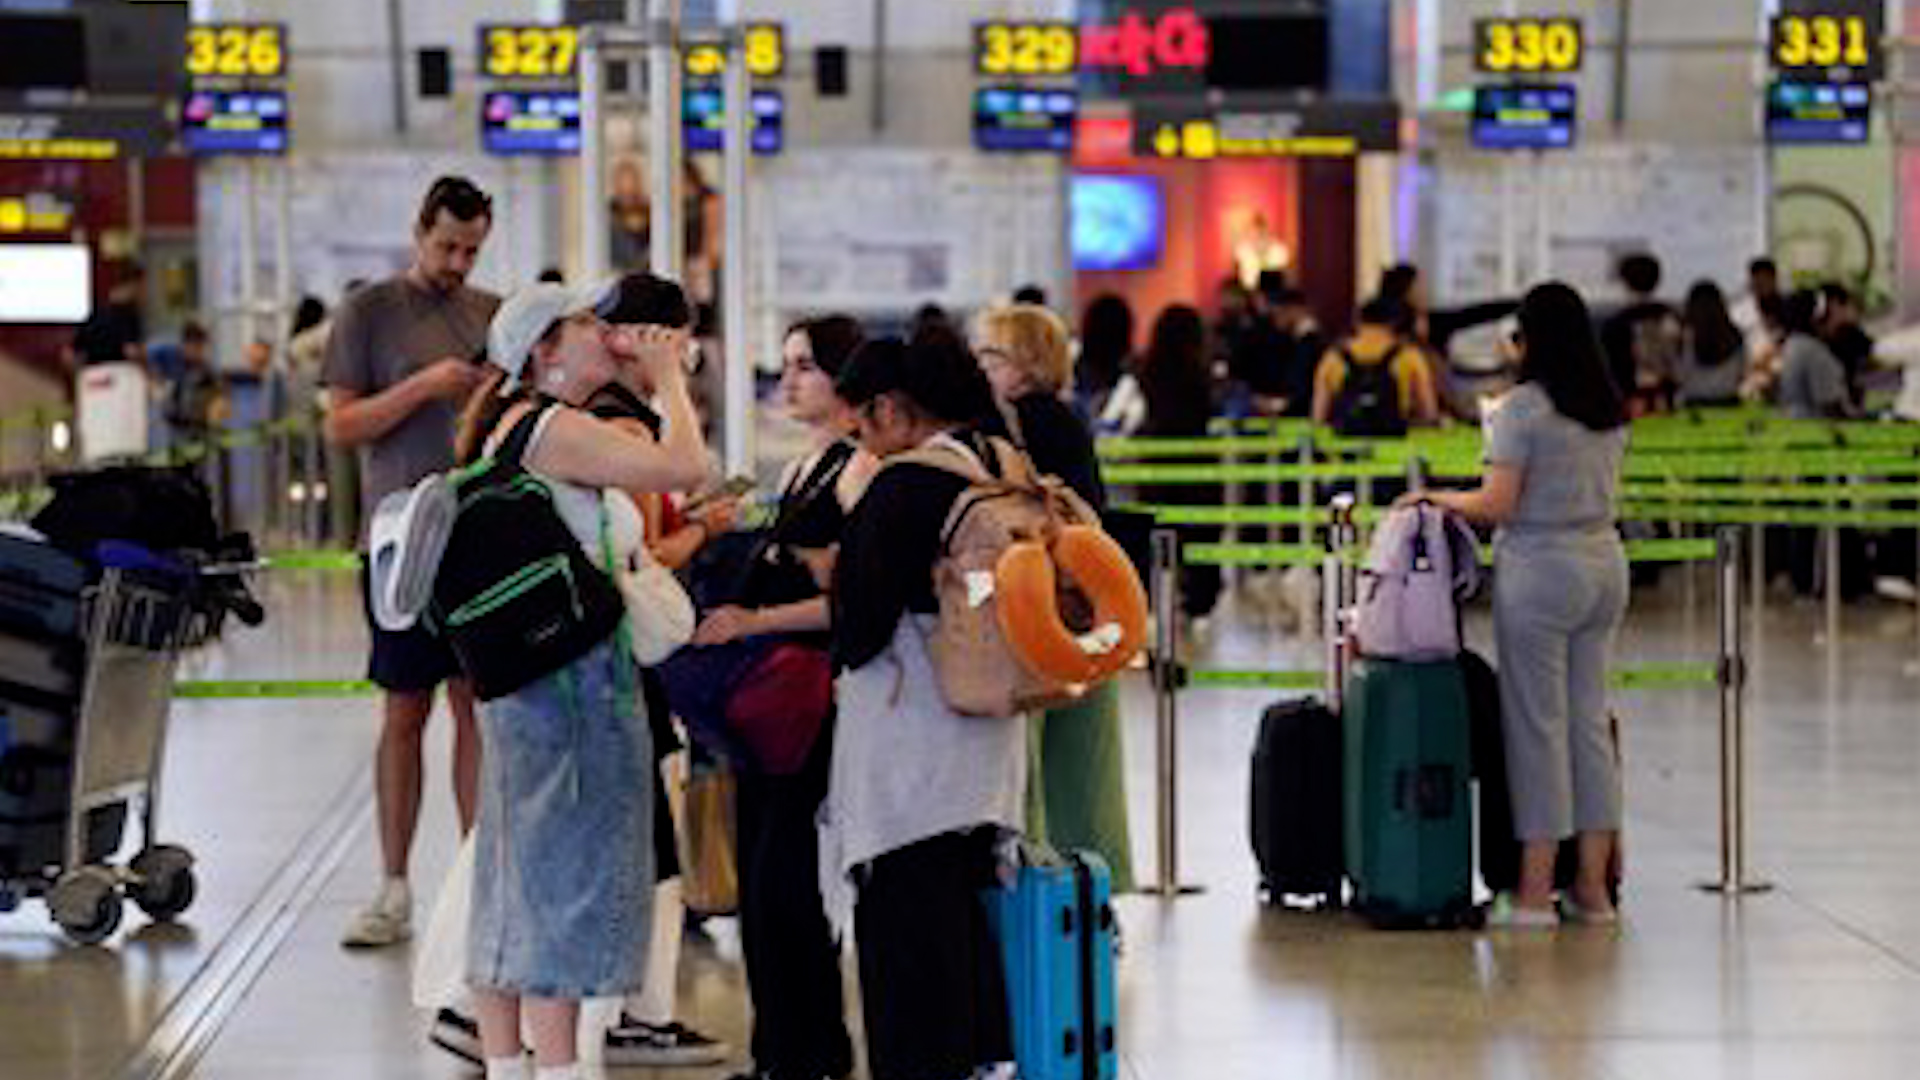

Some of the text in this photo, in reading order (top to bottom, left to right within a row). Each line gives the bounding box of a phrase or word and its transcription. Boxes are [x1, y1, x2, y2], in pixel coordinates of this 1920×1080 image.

[187, 27, 280, 75] 326
[491, 28, 578, 76] 327
[985, 25, 1076, 74] 329
[1484, 23, 1578, 71] 330
[1780, 18, 1868, 65] 331
